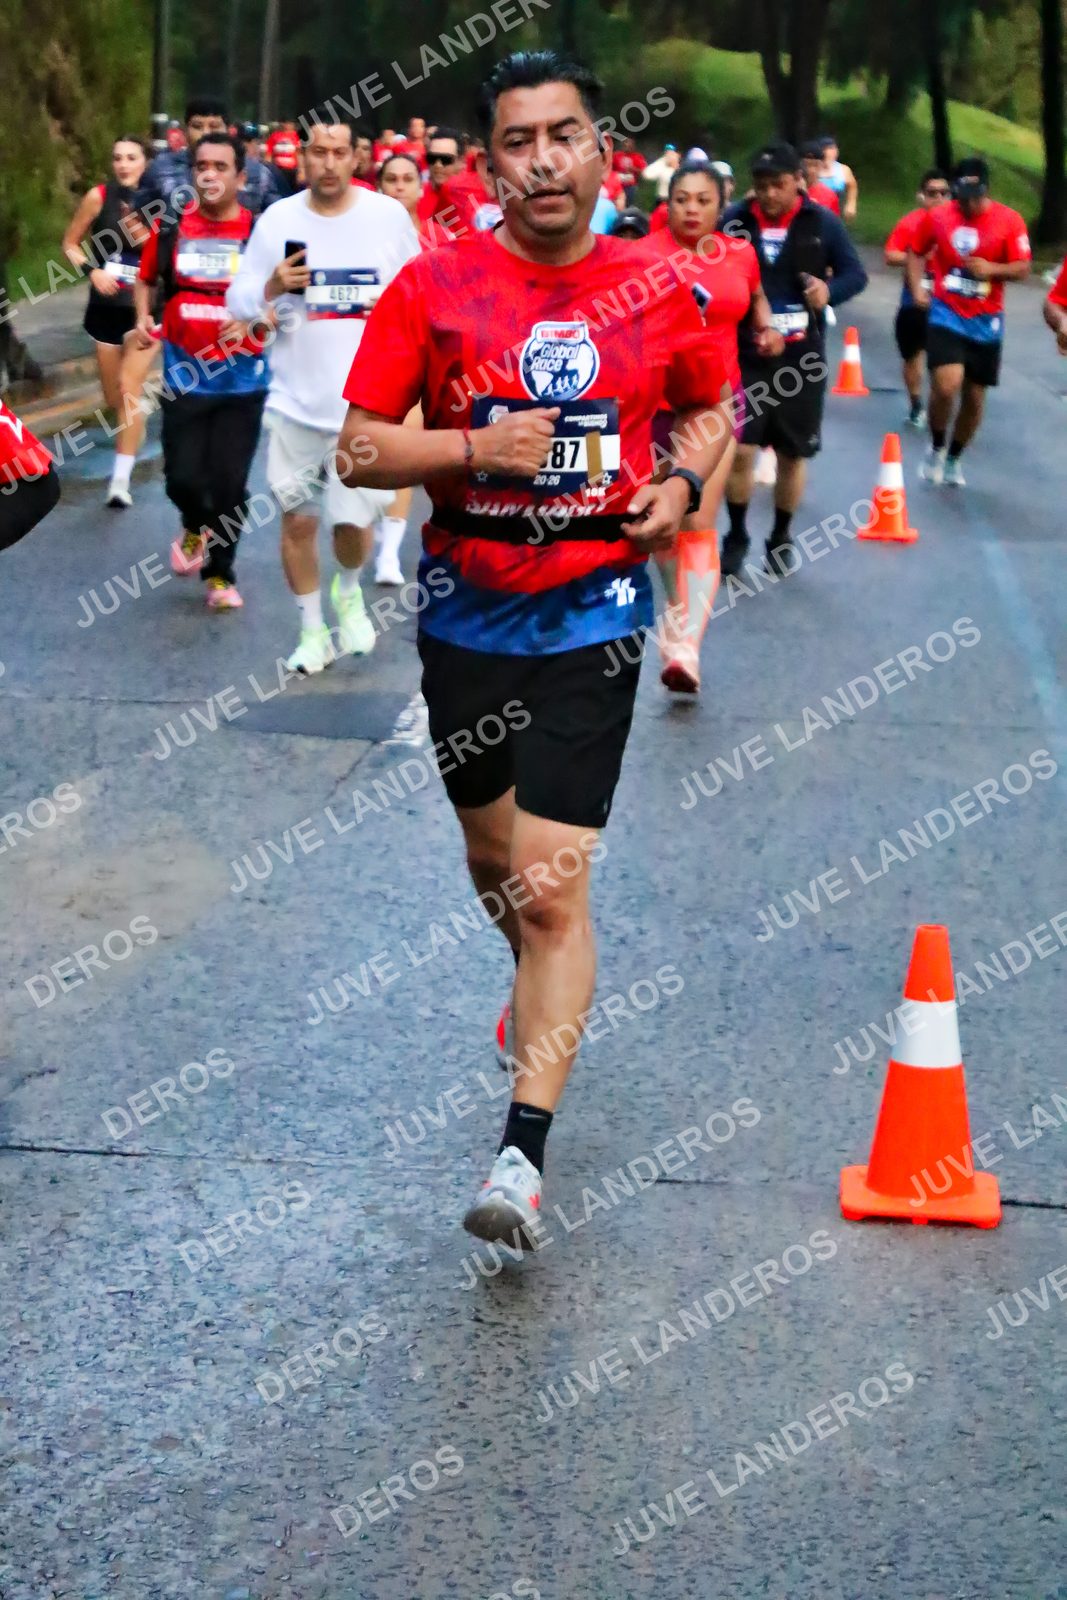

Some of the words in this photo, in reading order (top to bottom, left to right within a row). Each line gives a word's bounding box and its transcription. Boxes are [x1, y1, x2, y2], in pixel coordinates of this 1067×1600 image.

[540, 343, 580, 360] Global
[530, 356, 563, 372] Race
[541, 439, 580, 469] 87
